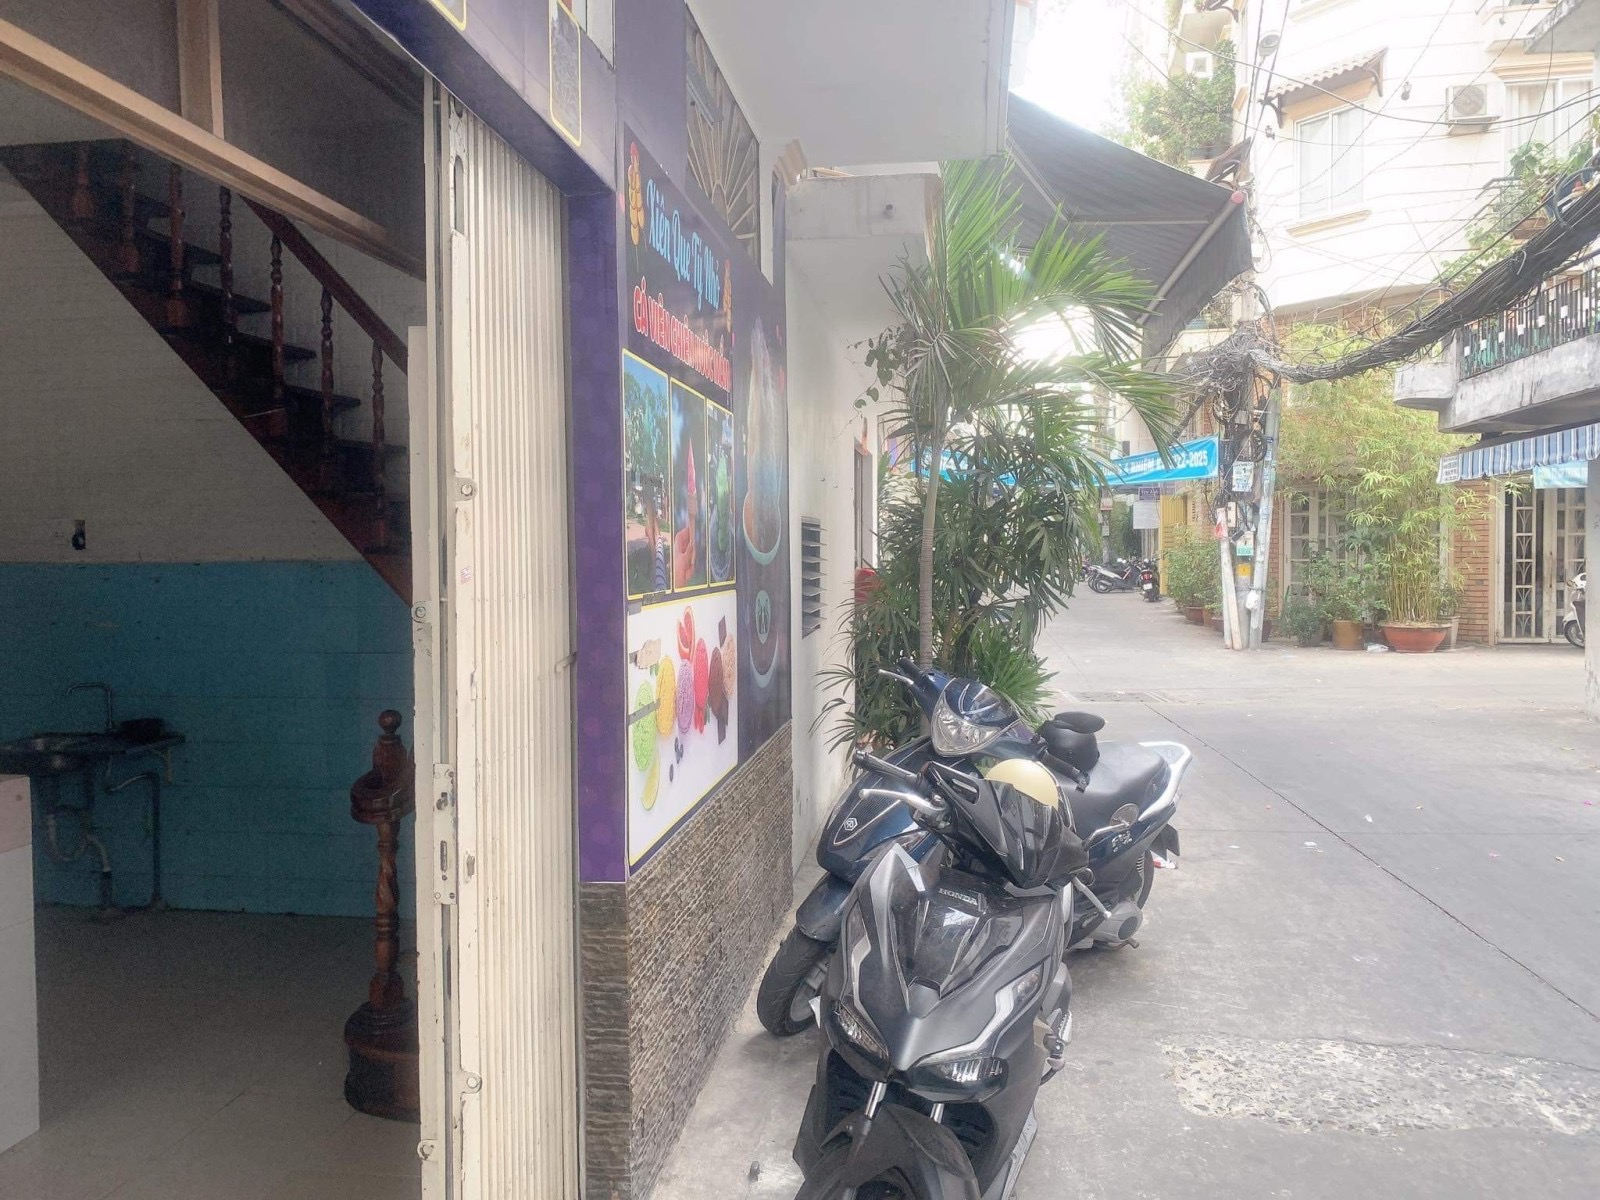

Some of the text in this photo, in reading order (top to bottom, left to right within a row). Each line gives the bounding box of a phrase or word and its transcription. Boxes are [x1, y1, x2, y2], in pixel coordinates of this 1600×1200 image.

[646, 178, 670, 263] Xiên
[672, 209, 690, 282] Que
[633, 275, 648, 337] CÁ
[648, 292, 670, 352] VIÊN
[938, 887, 978, 906] HONDA
